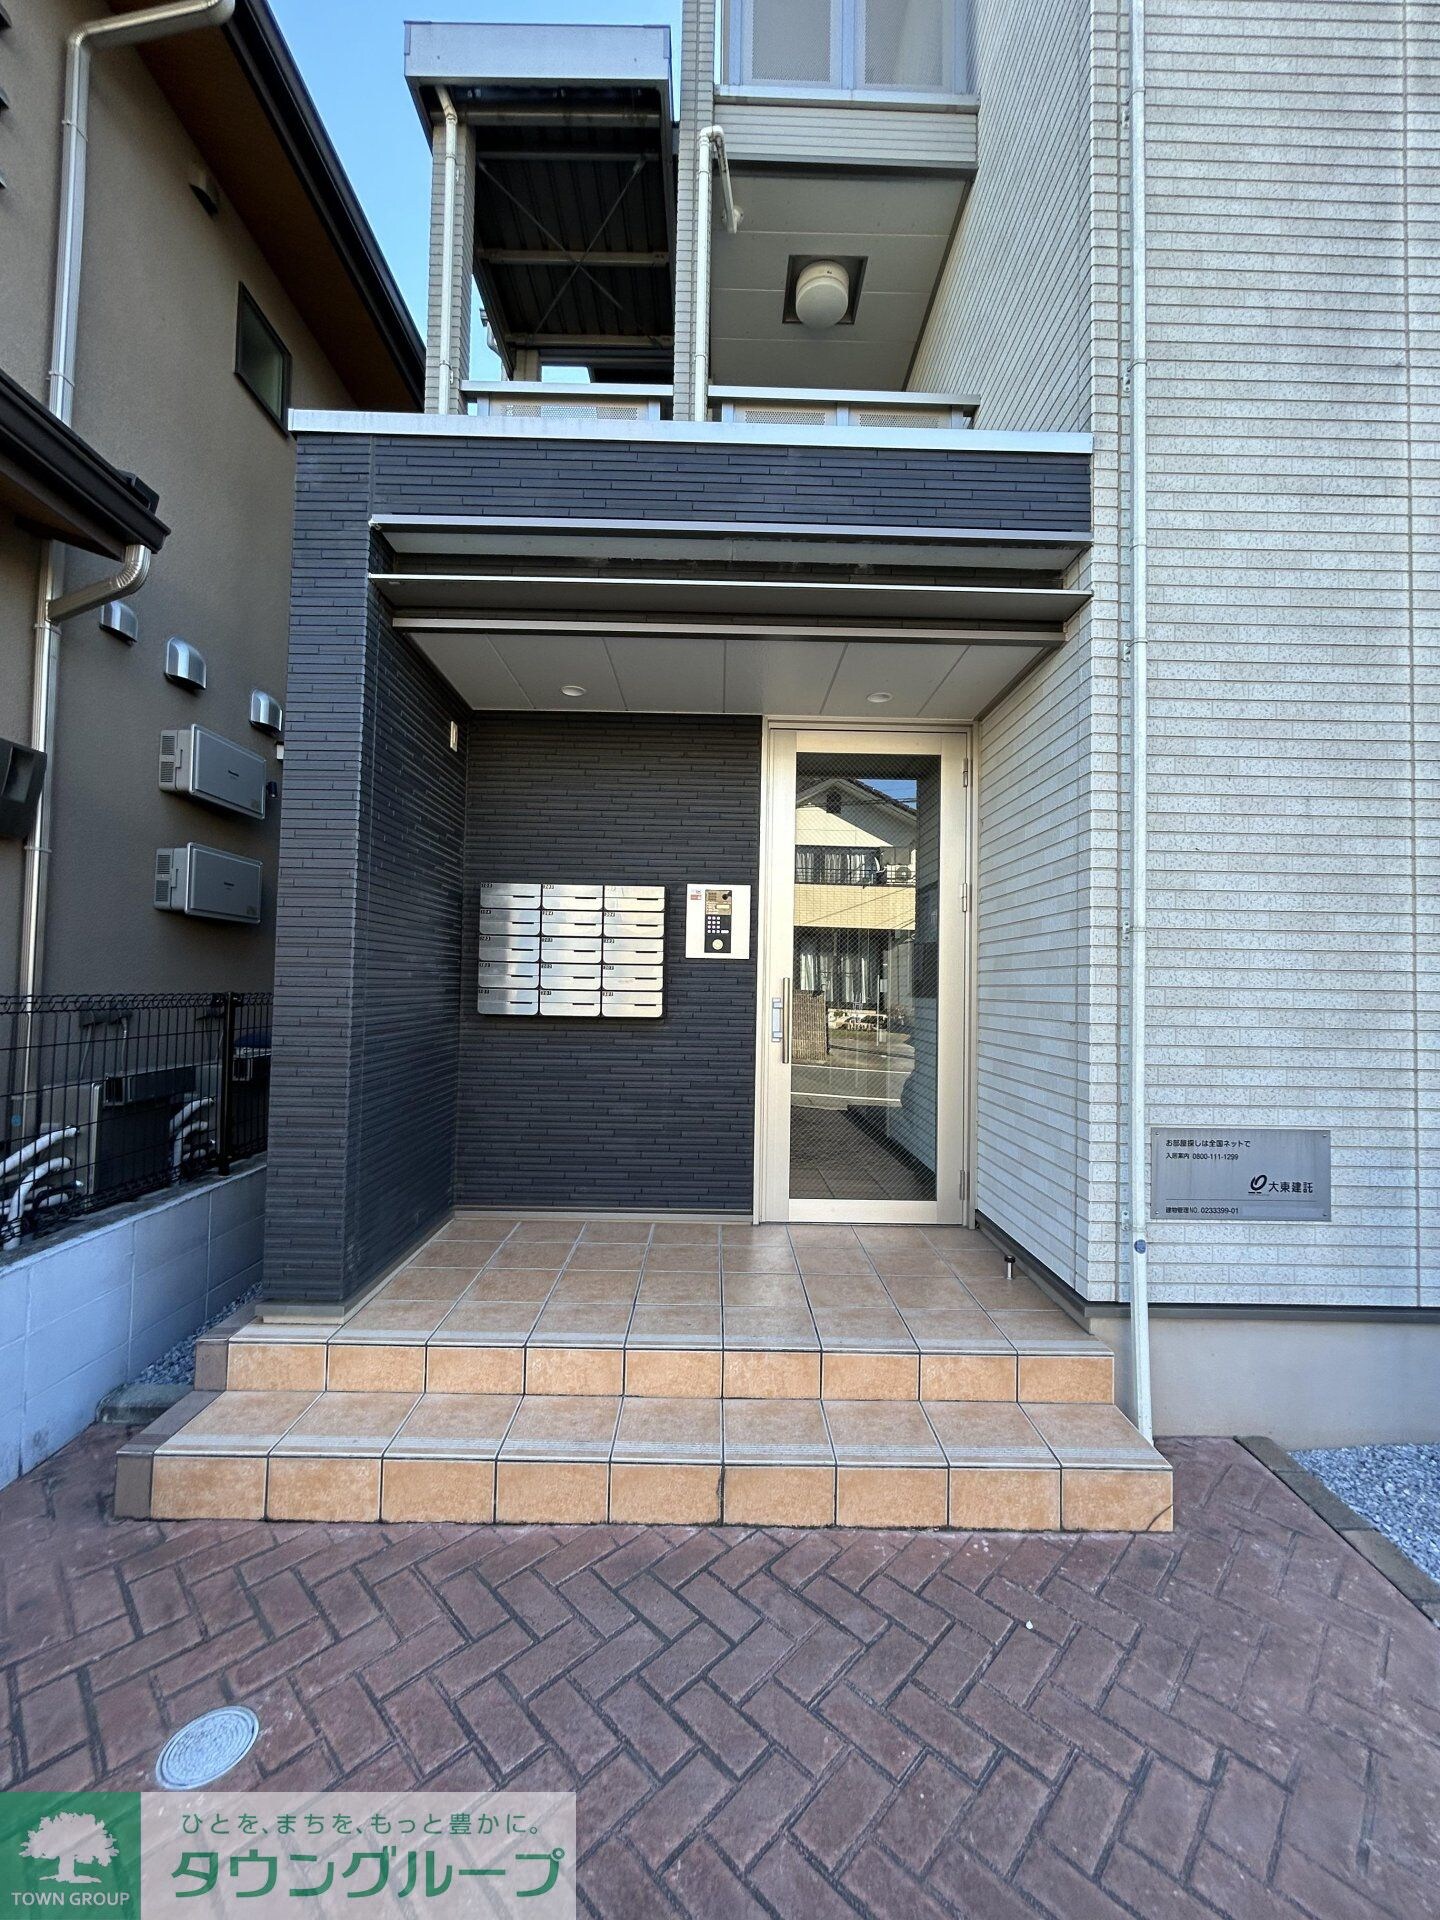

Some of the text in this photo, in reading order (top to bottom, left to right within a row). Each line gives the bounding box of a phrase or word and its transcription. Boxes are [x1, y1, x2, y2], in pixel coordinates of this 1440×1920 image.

[1166, 1139, 1251, 1148] お部屋探しは全国ネットで
[1192, 1153, 1239, 1161] 0800-111-1299
[1268, 1181, 1314, 1194] 大東建託
[1200, 1207, 1239, 1215] 0233399-01
